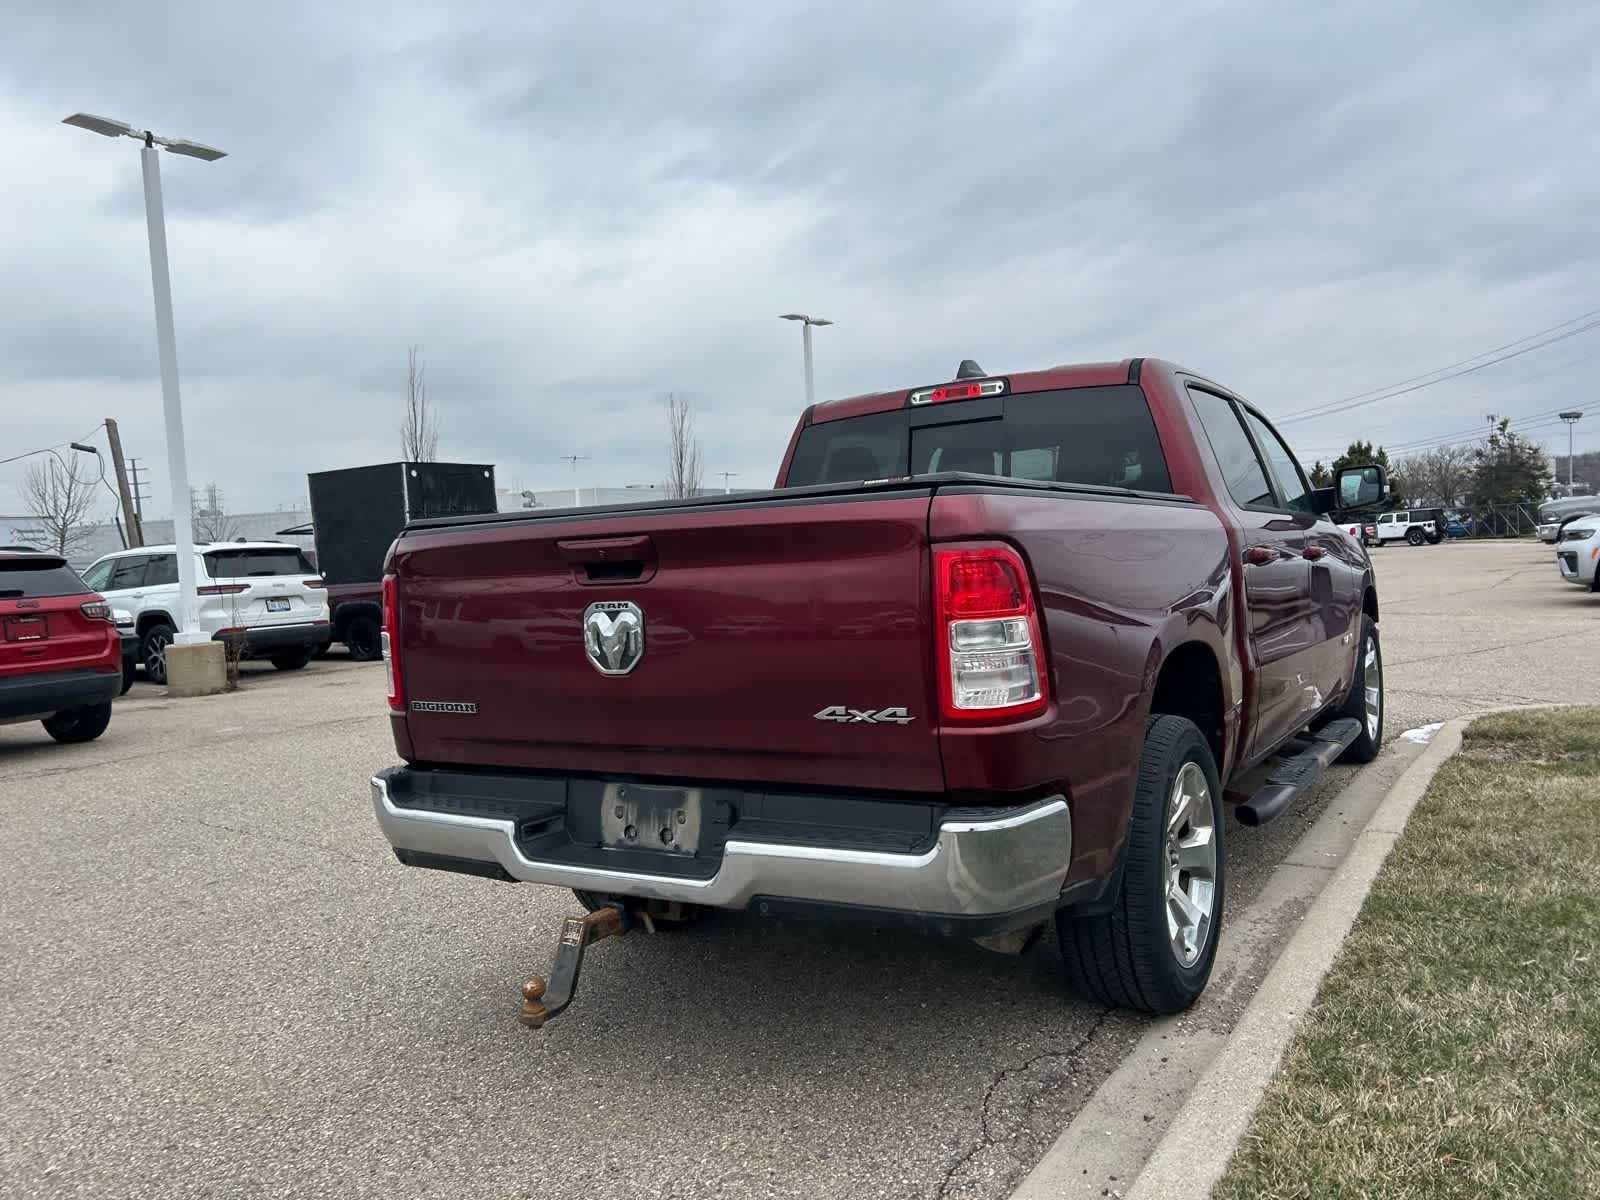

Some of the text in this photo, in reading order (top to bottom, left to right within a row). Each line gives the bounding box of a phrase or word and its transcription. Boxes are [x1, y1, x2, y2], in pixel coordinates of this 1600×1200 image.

[594, 602, 629, 610] RAM
[412, 701, 477, 713] BIGHORN
[813, 706, 916, 724] 4x4
